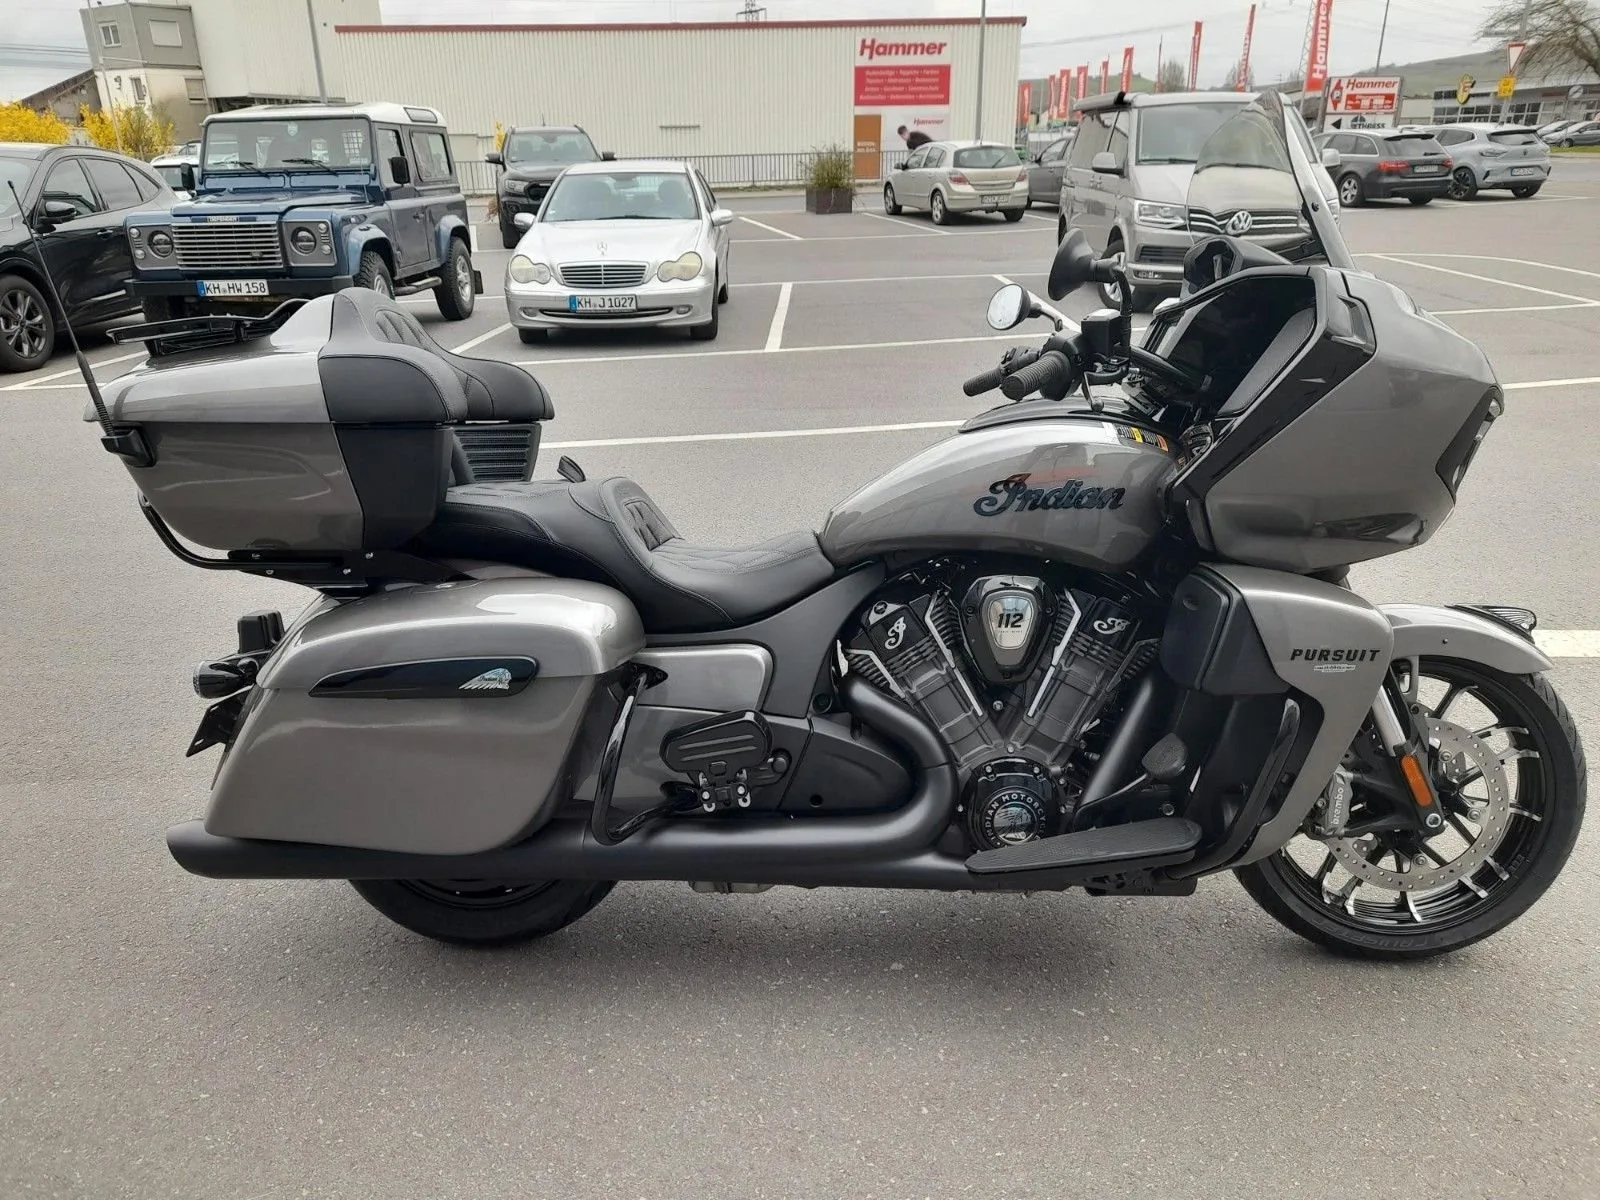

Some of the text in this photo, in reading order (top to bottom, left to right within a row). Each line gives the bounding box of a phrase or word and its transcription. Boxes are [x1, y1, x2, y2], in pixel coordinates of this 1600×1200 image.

[1312, 0, 1328, 79] Hamme
[859, 38, 947, 60] Hammer
[1346, 79, 1398, 91] Hammer
[914, 117, 944, 126] Hammer
[205, 282, 266, 294] KH HW 158
[577, 298, 591, 308] KH
[608, 297, 634, 308] 1027
[973, 473, 1126, 517] Indian
[997, 613, 1024, 628] 112
[1290, 648, 1380, 661] PURSUIT
[1331, 786, 1344, 825] brembo
